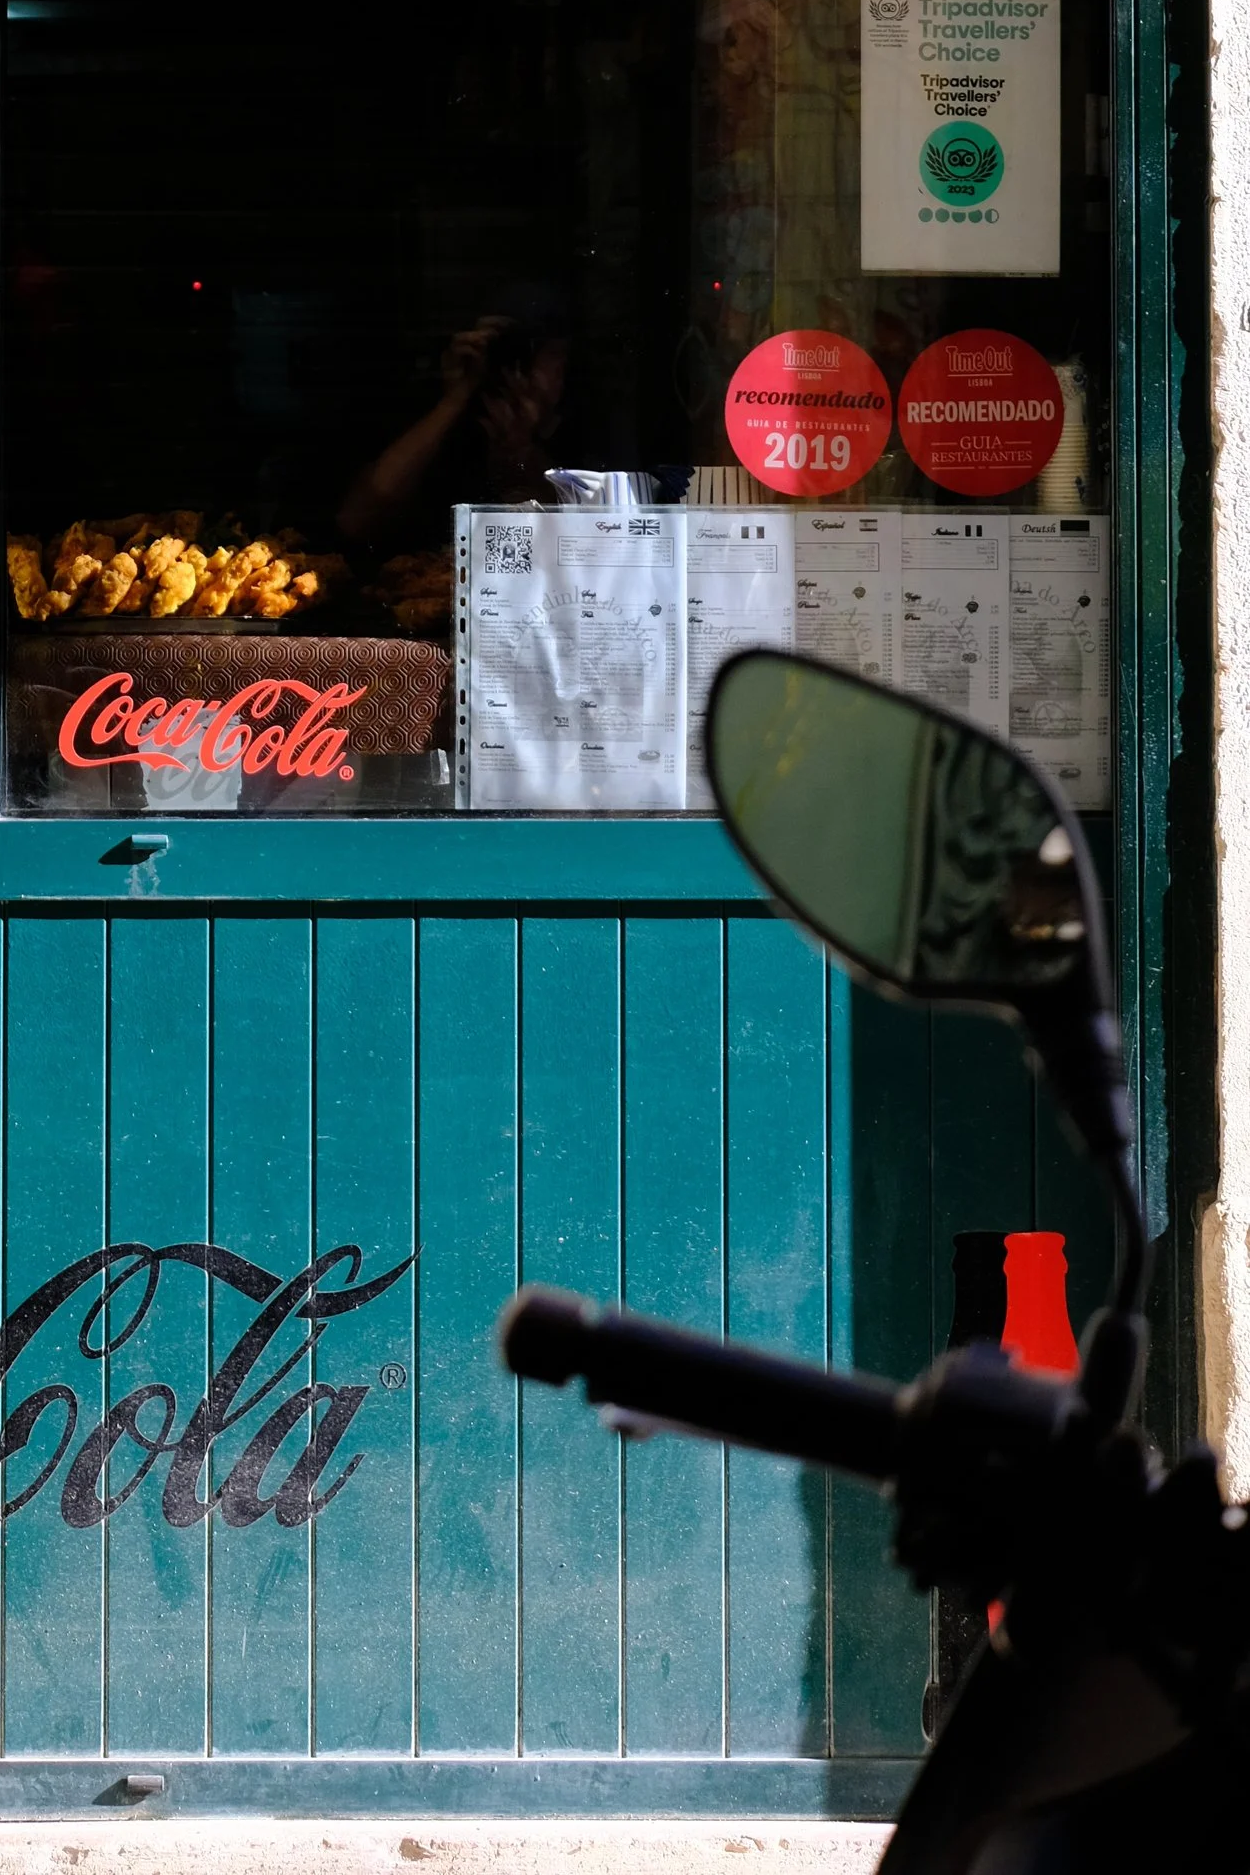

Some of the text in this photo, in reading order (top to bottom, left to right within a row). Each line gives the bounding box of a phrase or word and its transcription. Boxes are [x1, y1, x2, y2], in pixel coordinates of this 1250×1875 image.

[918, 42, 1001, 62] Choice
[920, 74, 1006, 90] Tripadvisor
[934, 103, 988, 117] Choice
[946, 184, 976, 196] 2023
[797, 371, 822, 381] LISBOA
[967, 378, 993, 387] LISBOA
[734, 387, 886, 411] recomendado
[906, 399, 1056, 424] RECOMENDADO
[746, 419, 770, 429] GUIA
[775, 420, 788, 429] DE
[959, 435, 1004, 450] GUIA
[764, 432, 851, 471] 2019
[930, 450, 1033, 464] RESTAURANTES
[58, 671, 368, 778] Coca-Cola
